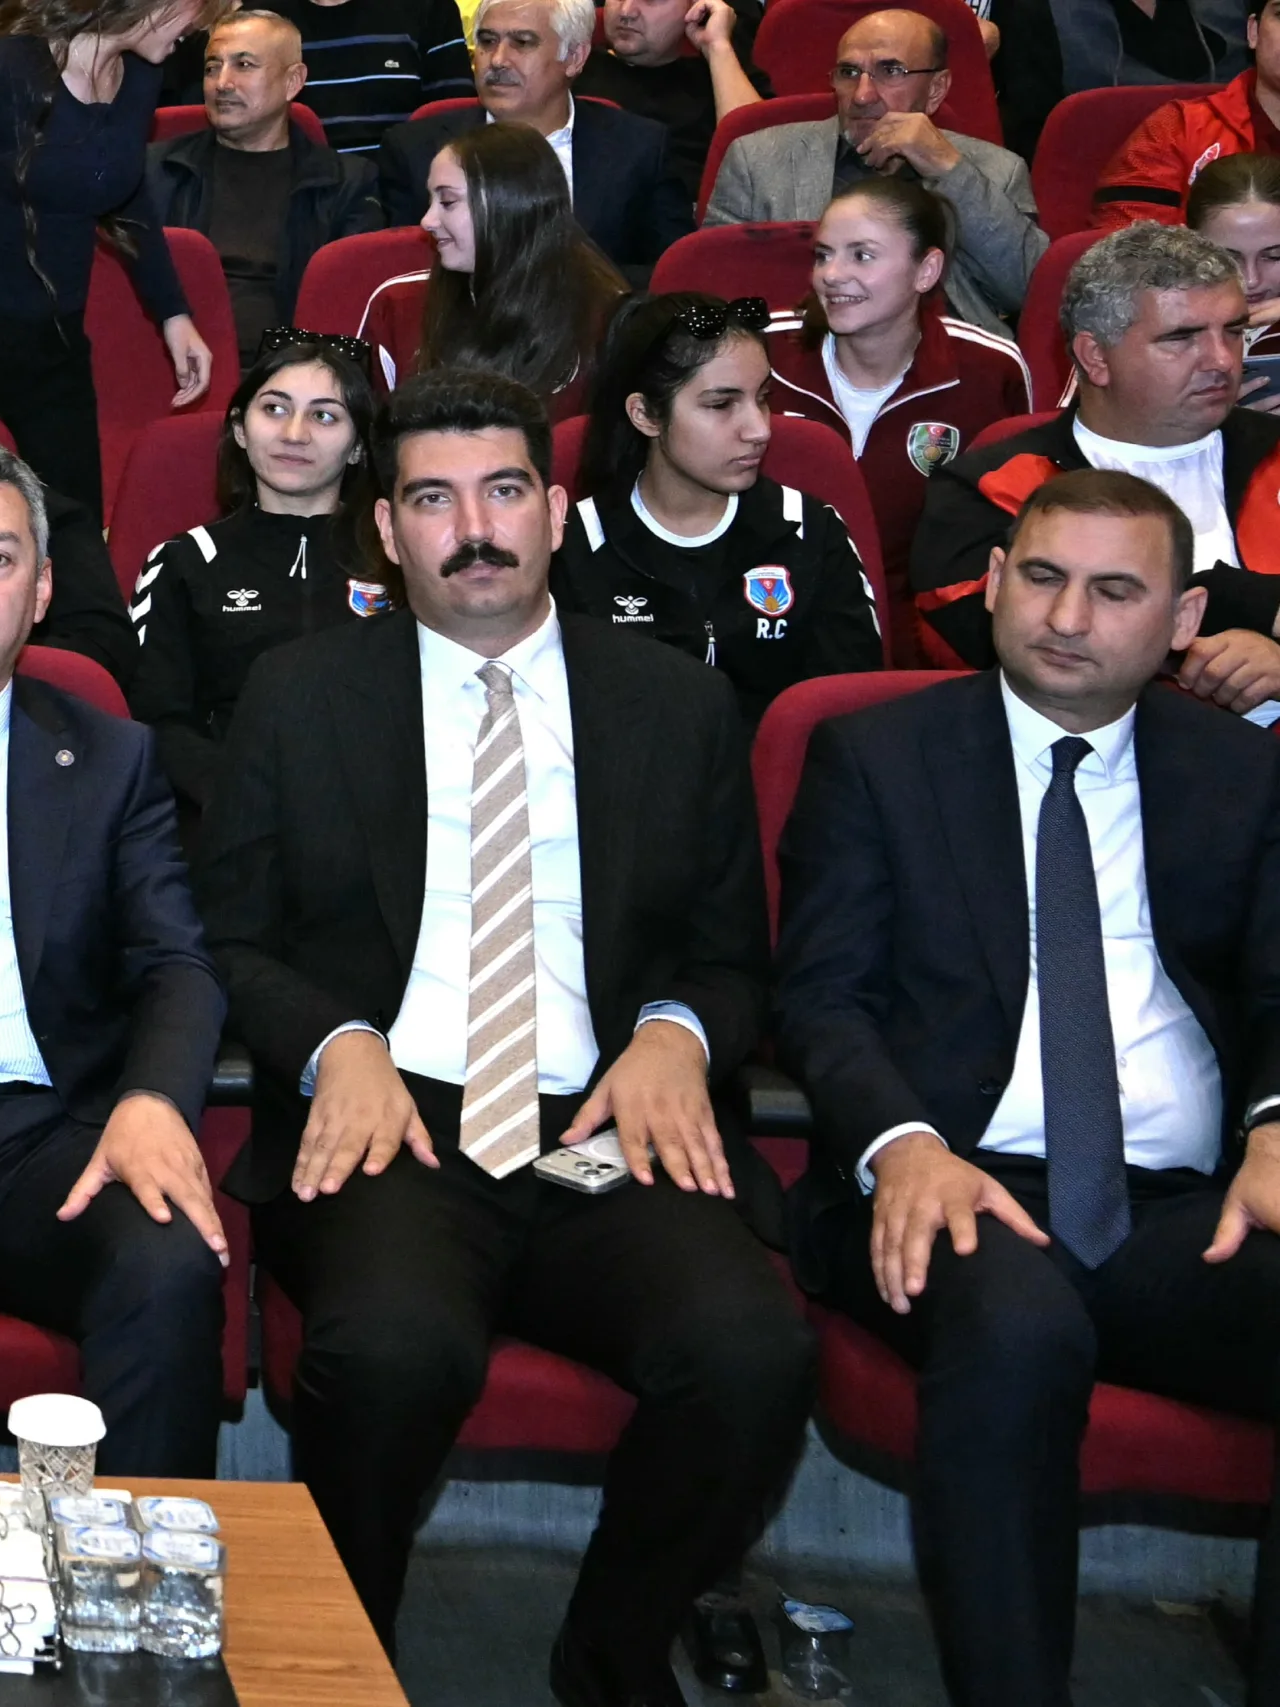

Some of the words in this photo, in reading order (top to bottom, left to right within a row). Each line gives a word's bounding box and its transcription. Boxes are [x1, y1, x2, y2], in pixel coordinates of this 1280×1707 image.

[222, 603, 262, 613] hummel
[612, 613, 655, 624] hummel
[756, 617, 788, 640] R.C
